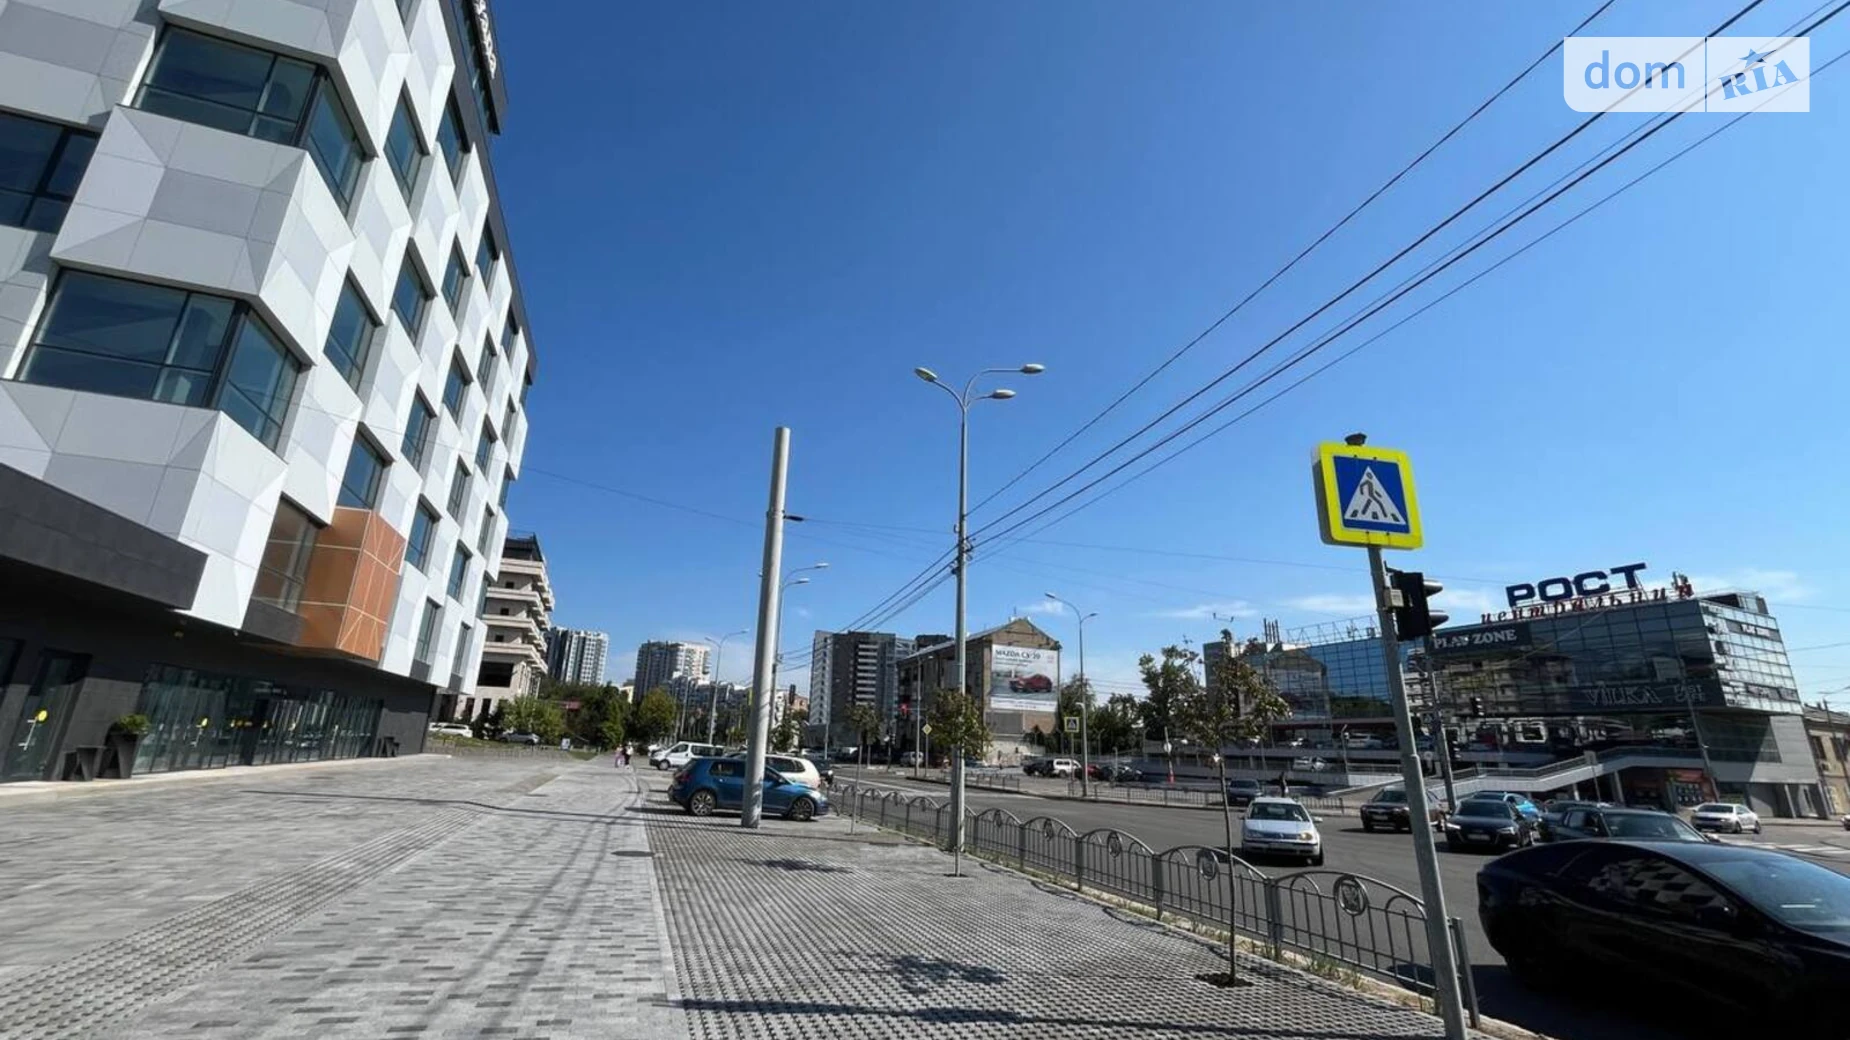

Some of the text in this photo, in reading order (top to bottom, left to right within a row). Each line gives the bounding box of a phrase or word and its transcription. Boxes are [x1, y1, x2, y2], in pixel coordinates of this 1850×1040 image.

[1505, 562, 1648, 607] РОСТ
[1433, 629, 1517, 649] PLAY ZONE
[995, 649, 1020, 657] MAZDA
